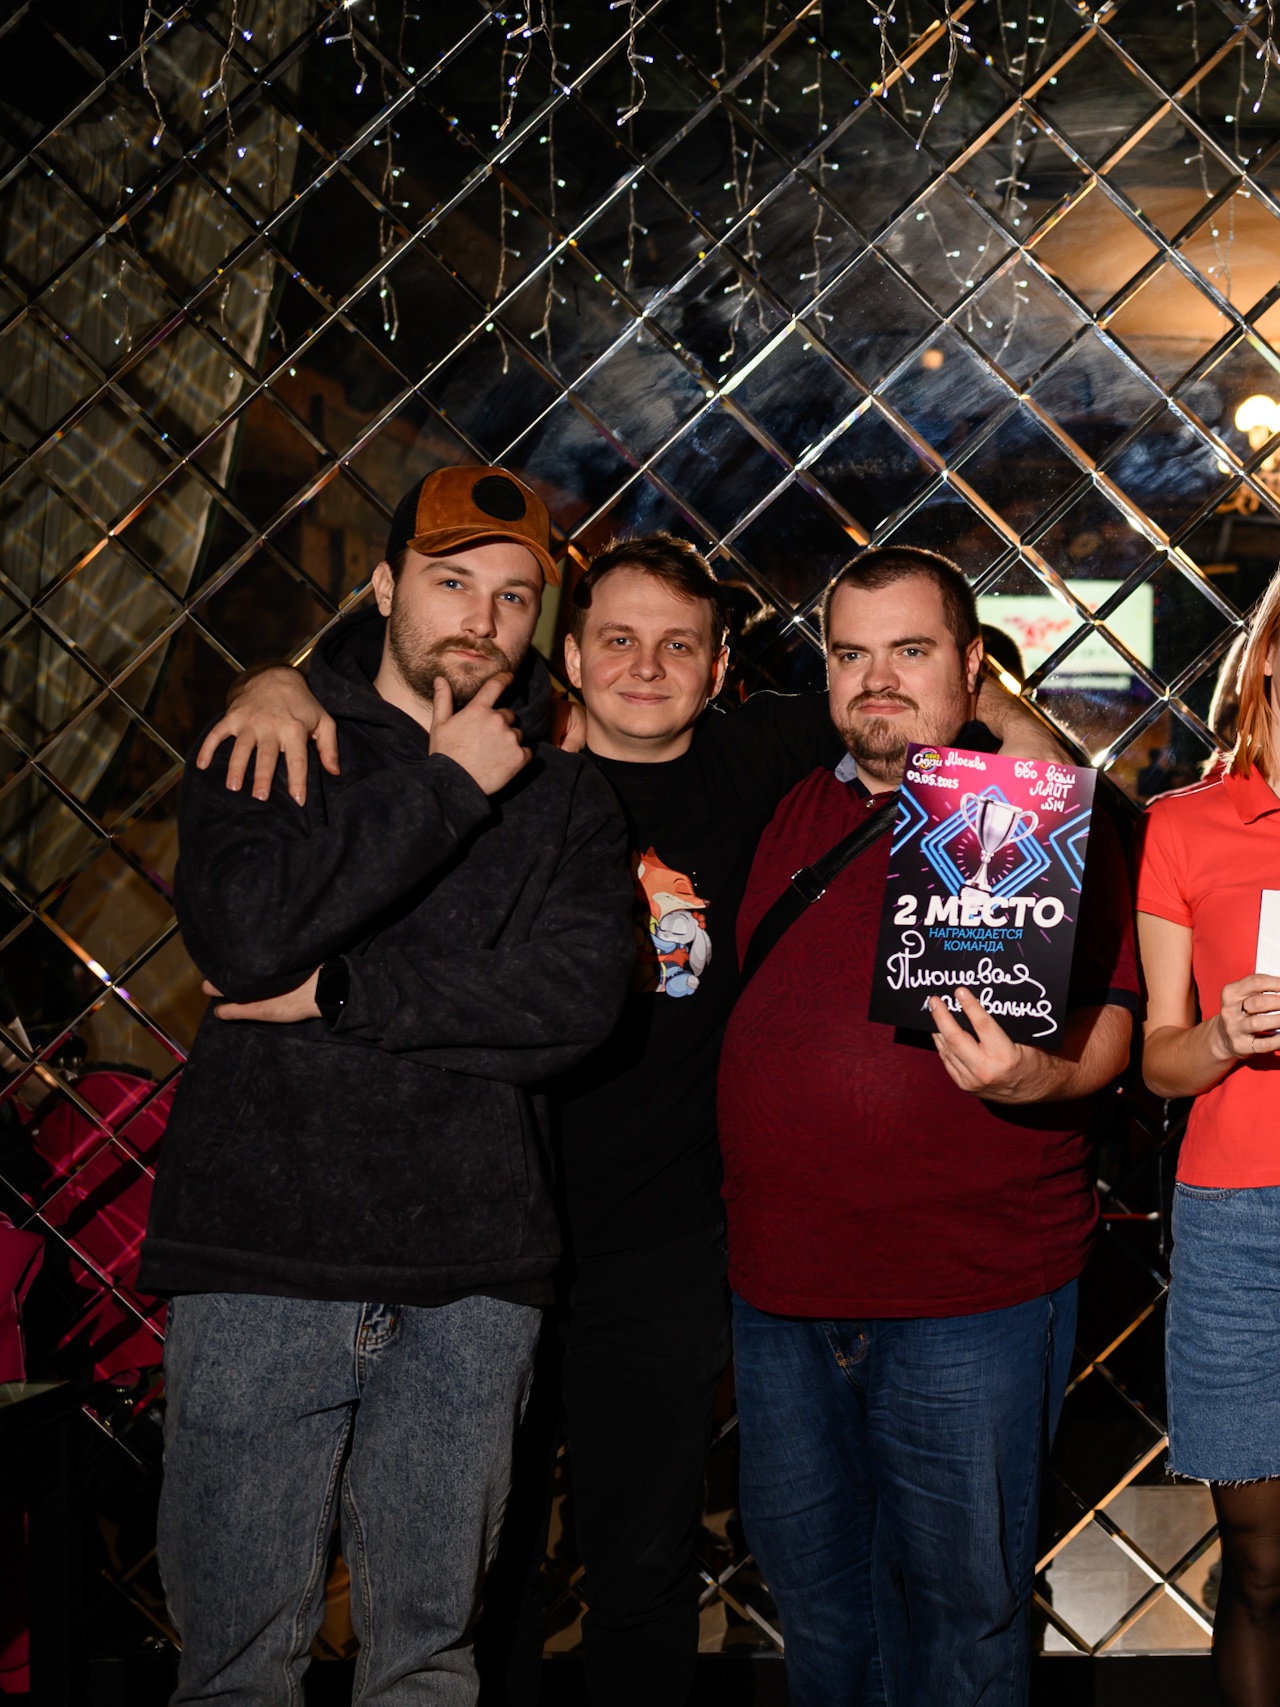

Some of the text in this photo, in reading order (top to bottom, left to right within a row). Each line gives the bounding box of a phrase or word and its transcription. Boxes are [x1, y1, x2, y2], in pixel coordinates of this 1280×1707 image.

[945, 751, 987, 771] Москва
[894, 894, 1065, 928] 2 МЕСТО
[929, 927, 1024, 940] НАГРАЖДАЕТСЯ
[944, 940, 1004, 953] КОМАНДА
[886, 930, 1047, 998] Плюшевая
